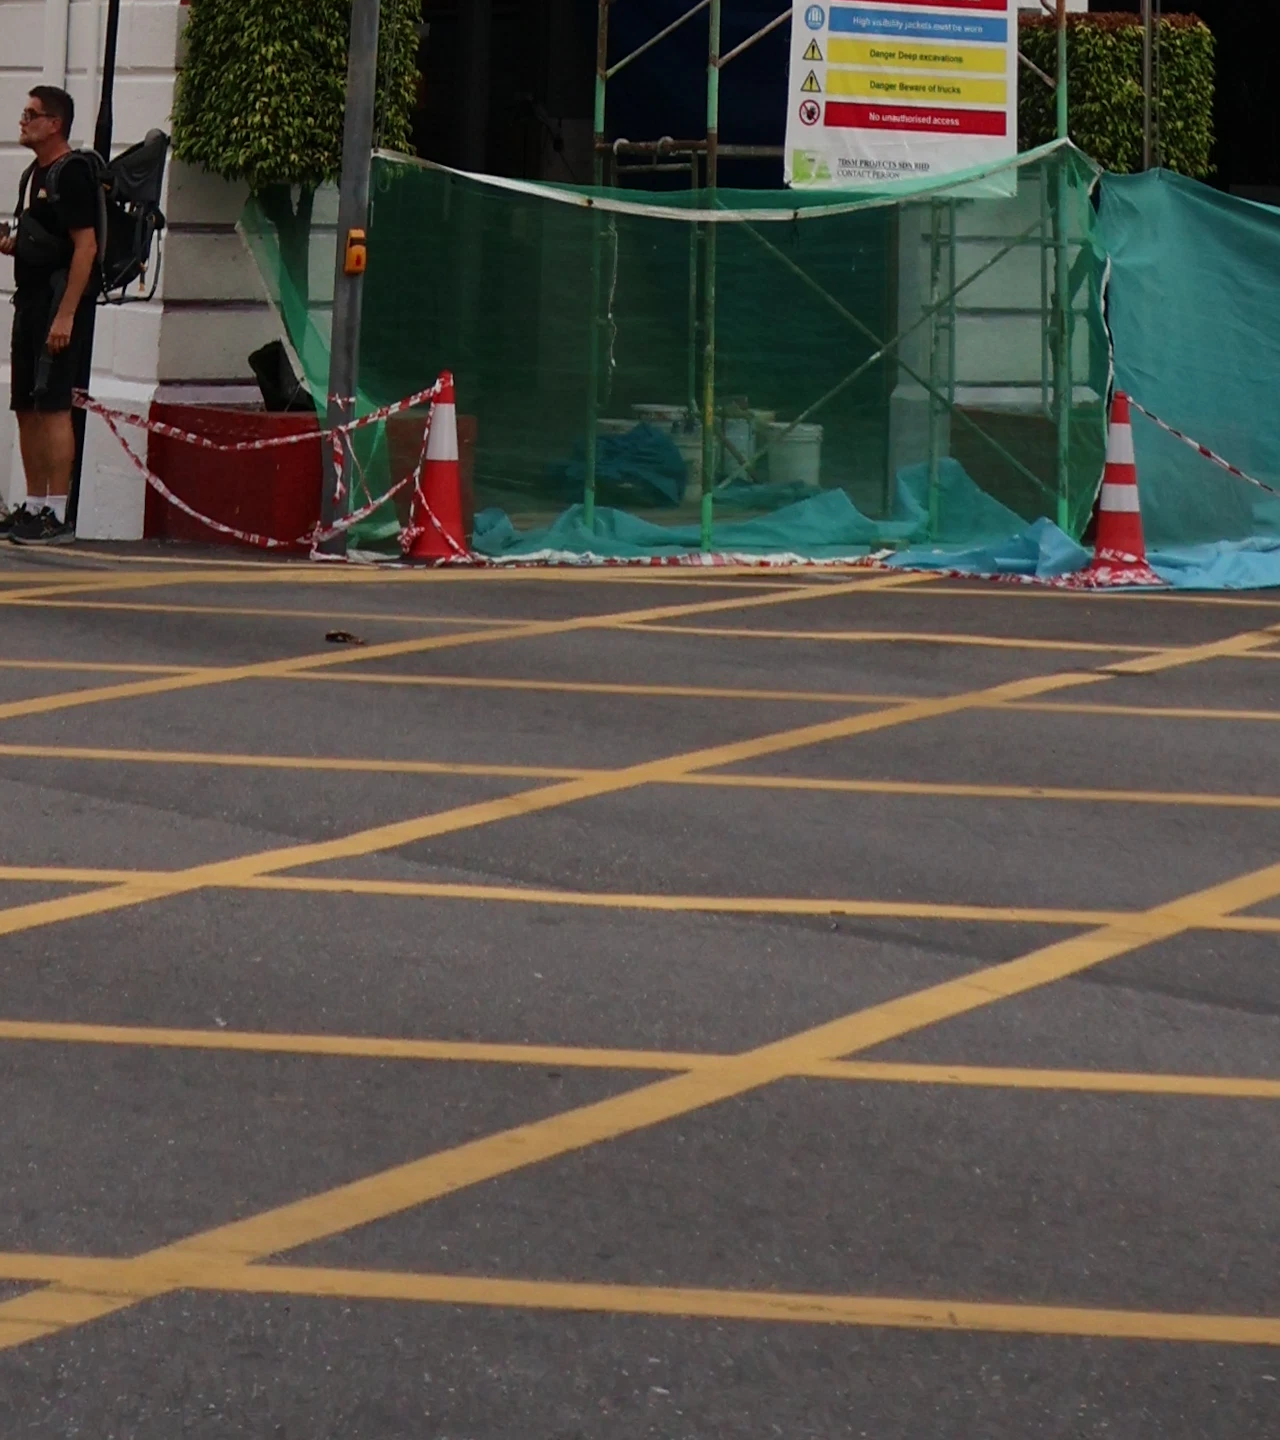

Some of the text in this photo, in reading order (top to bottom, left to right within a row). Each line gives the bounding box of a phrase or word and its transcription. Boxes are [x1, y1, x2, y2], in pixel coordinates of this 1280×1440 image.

[853, 16, 870, 28] High
[904, 20, 932, 30] jackets
[952, 23, 962, 32] be
[964, 25, 983, 33] worn
[869, 48, 963, 63] Danger Deep excavations
[869, 80, 961, 94] Danger Beware of trucks
[869, 112, 960, 126] No unauthorised access
